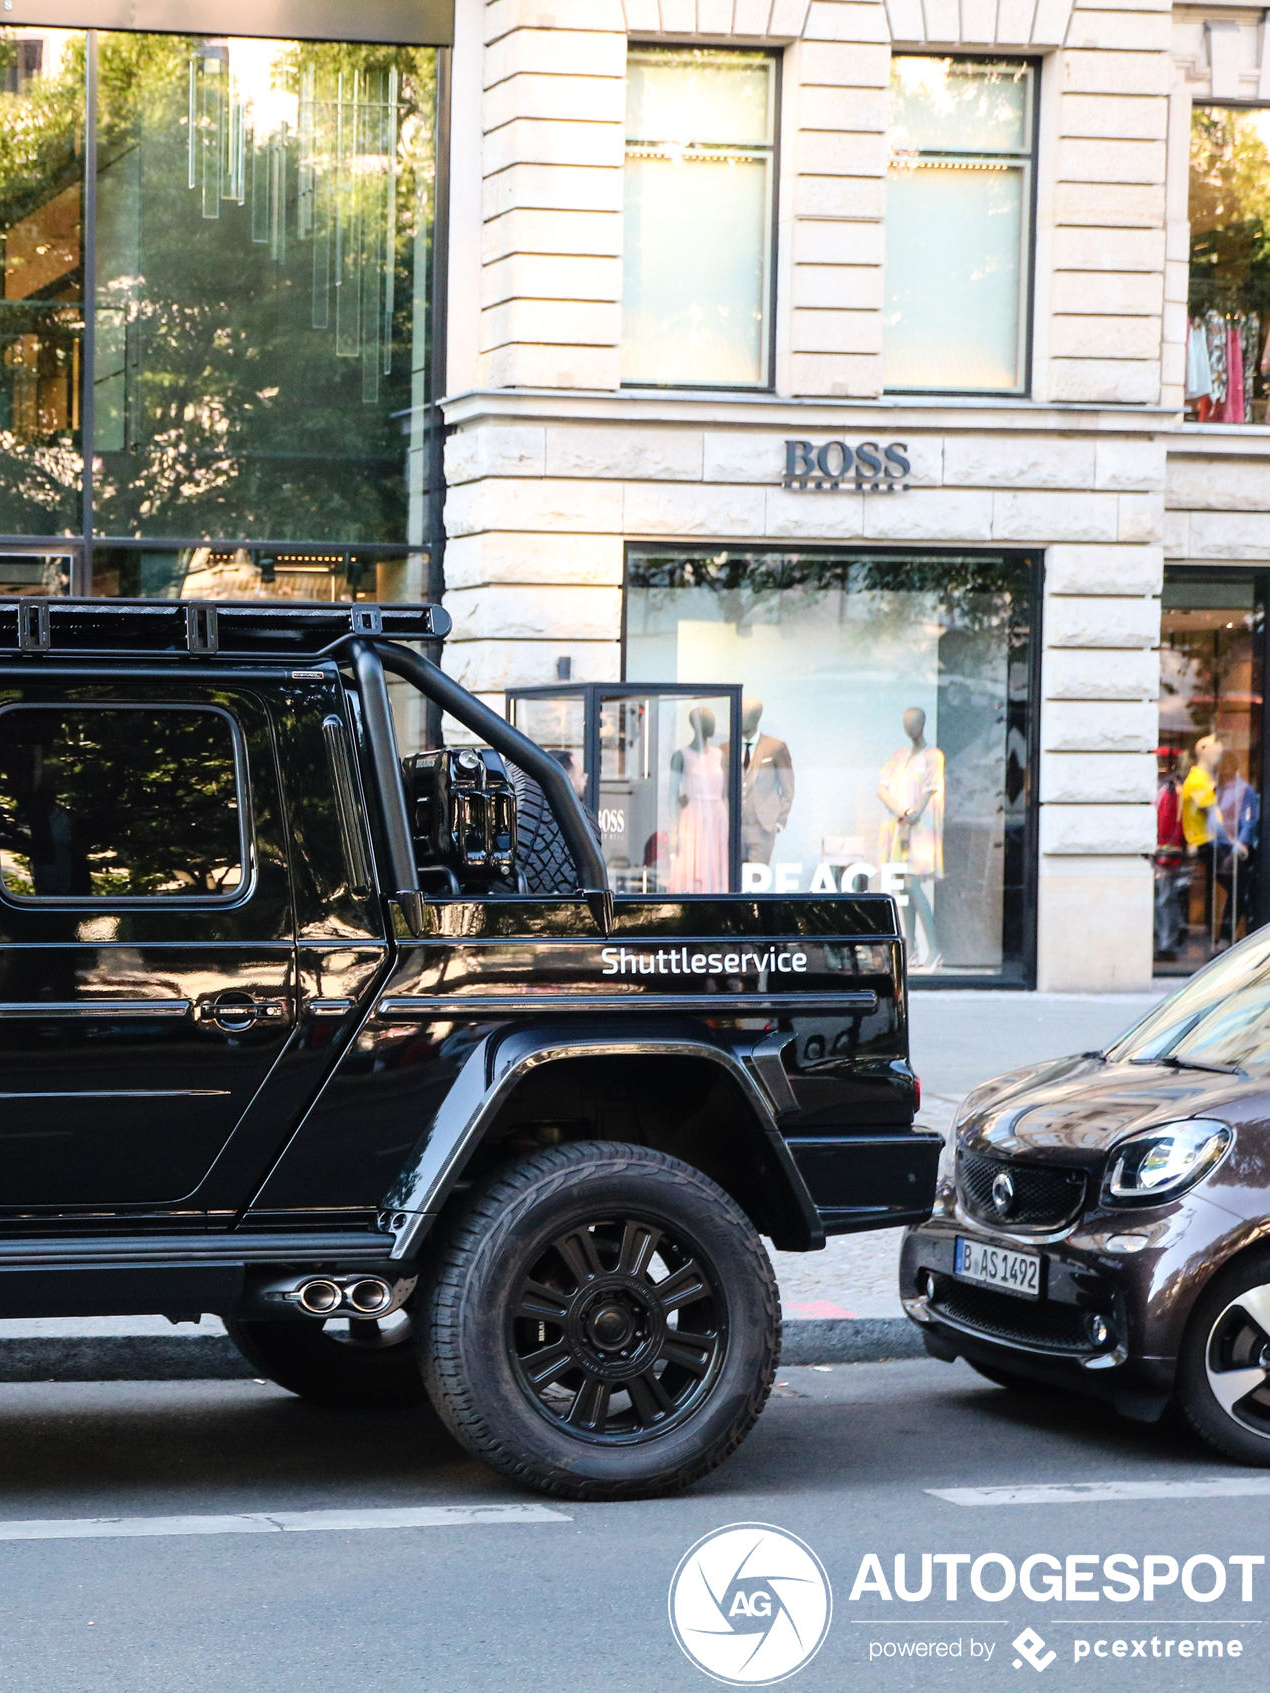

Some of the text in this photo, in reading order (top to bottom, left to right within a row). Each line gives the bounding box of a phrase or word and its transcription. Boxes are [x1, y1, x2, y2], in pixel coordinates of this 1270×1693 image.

[784, 440, 911, 479] BOSS
[741, 862, 910, 907] PEACE
[601, 946, 808, 975] Shuttleservice
[963, 1244, 972, 1272] B
